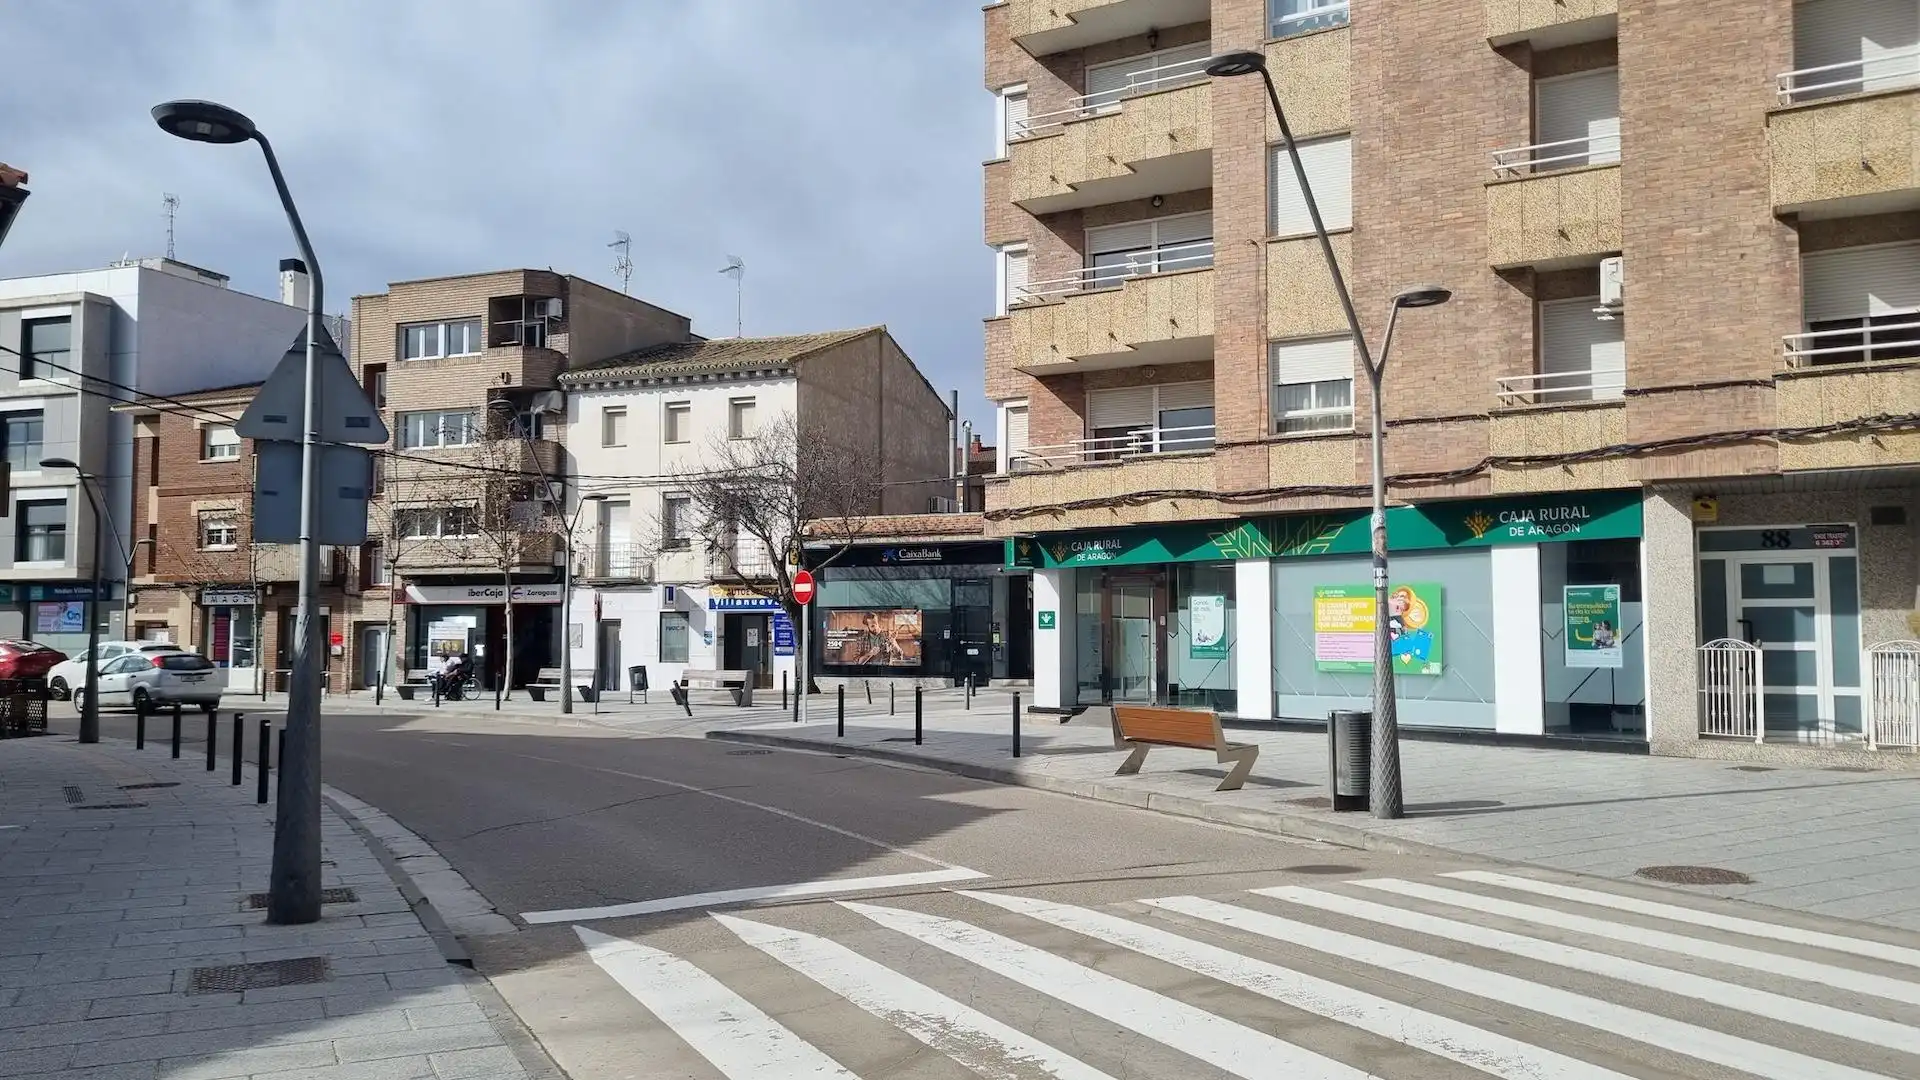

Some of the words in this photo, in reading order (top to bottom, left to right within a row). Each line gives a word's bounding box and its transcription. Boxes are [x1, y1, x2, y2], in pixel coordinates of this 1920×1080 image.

[1500, 510, 1535, 523] CAJA
[1540, 506, 1590, 520] RURAL
[1509, 526, 1524, 536] DE
[1528, 522, 1580, 535] ARAGÓN
[1071, 540, 1093, 552] CAJA
[1093, 539, 1122, 550] RURAL
[1762, 530, 1791, 548] 88
[898, 548, 942, 559] CaixaBank
[1077, 553, 1086, 562] DE
[1087, 551, 1116, 561] ARAGÓN
[468, 588, 504, 599] iberCaja
[527, 586, 557, 597] Zaragoza
